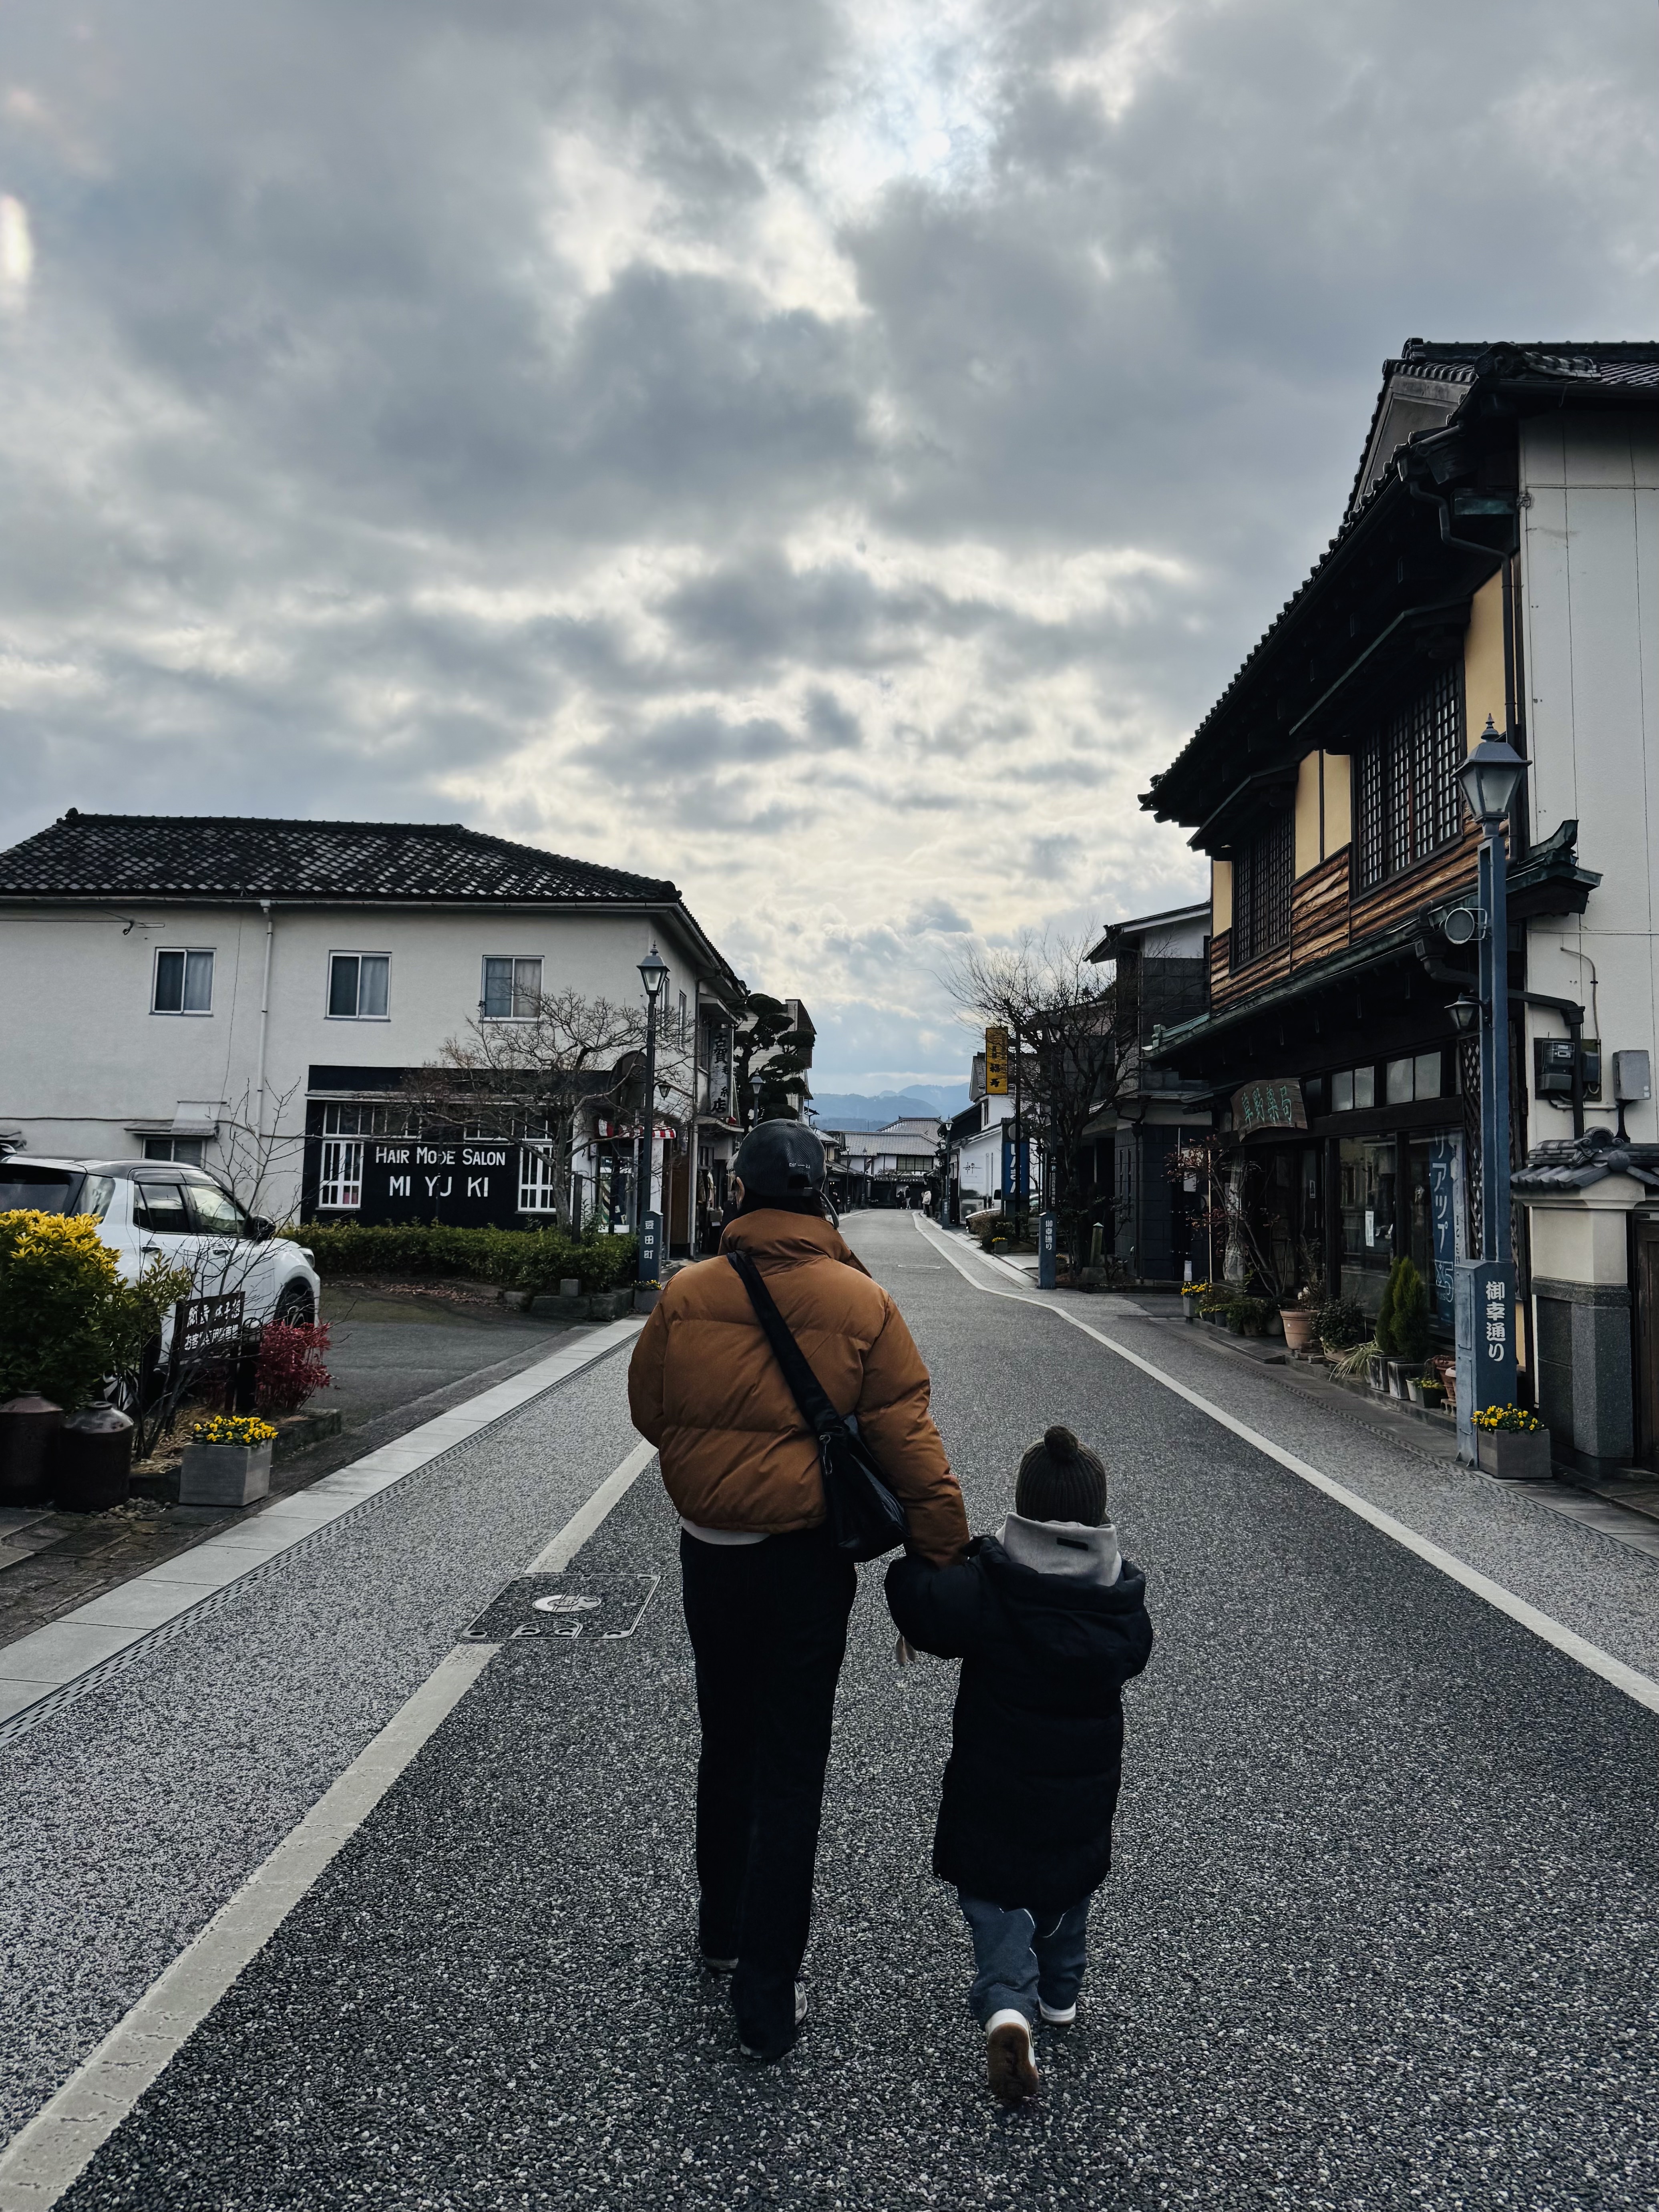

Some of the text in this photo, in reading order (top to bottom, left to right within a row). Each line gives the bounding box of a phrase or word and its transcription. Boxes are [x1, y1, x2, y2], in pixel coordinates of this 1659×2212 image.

[376, 1146, 410, 1163] HAIR
[463, 1148, 505, 1166] SALON
[390, 1176, 410, 1196] MI
[467, 1176, 489, 1197] KI
[644, 1220, 654, 1259] 豆田町
[1486, 1281, 1506, 1361] 御幸通り
